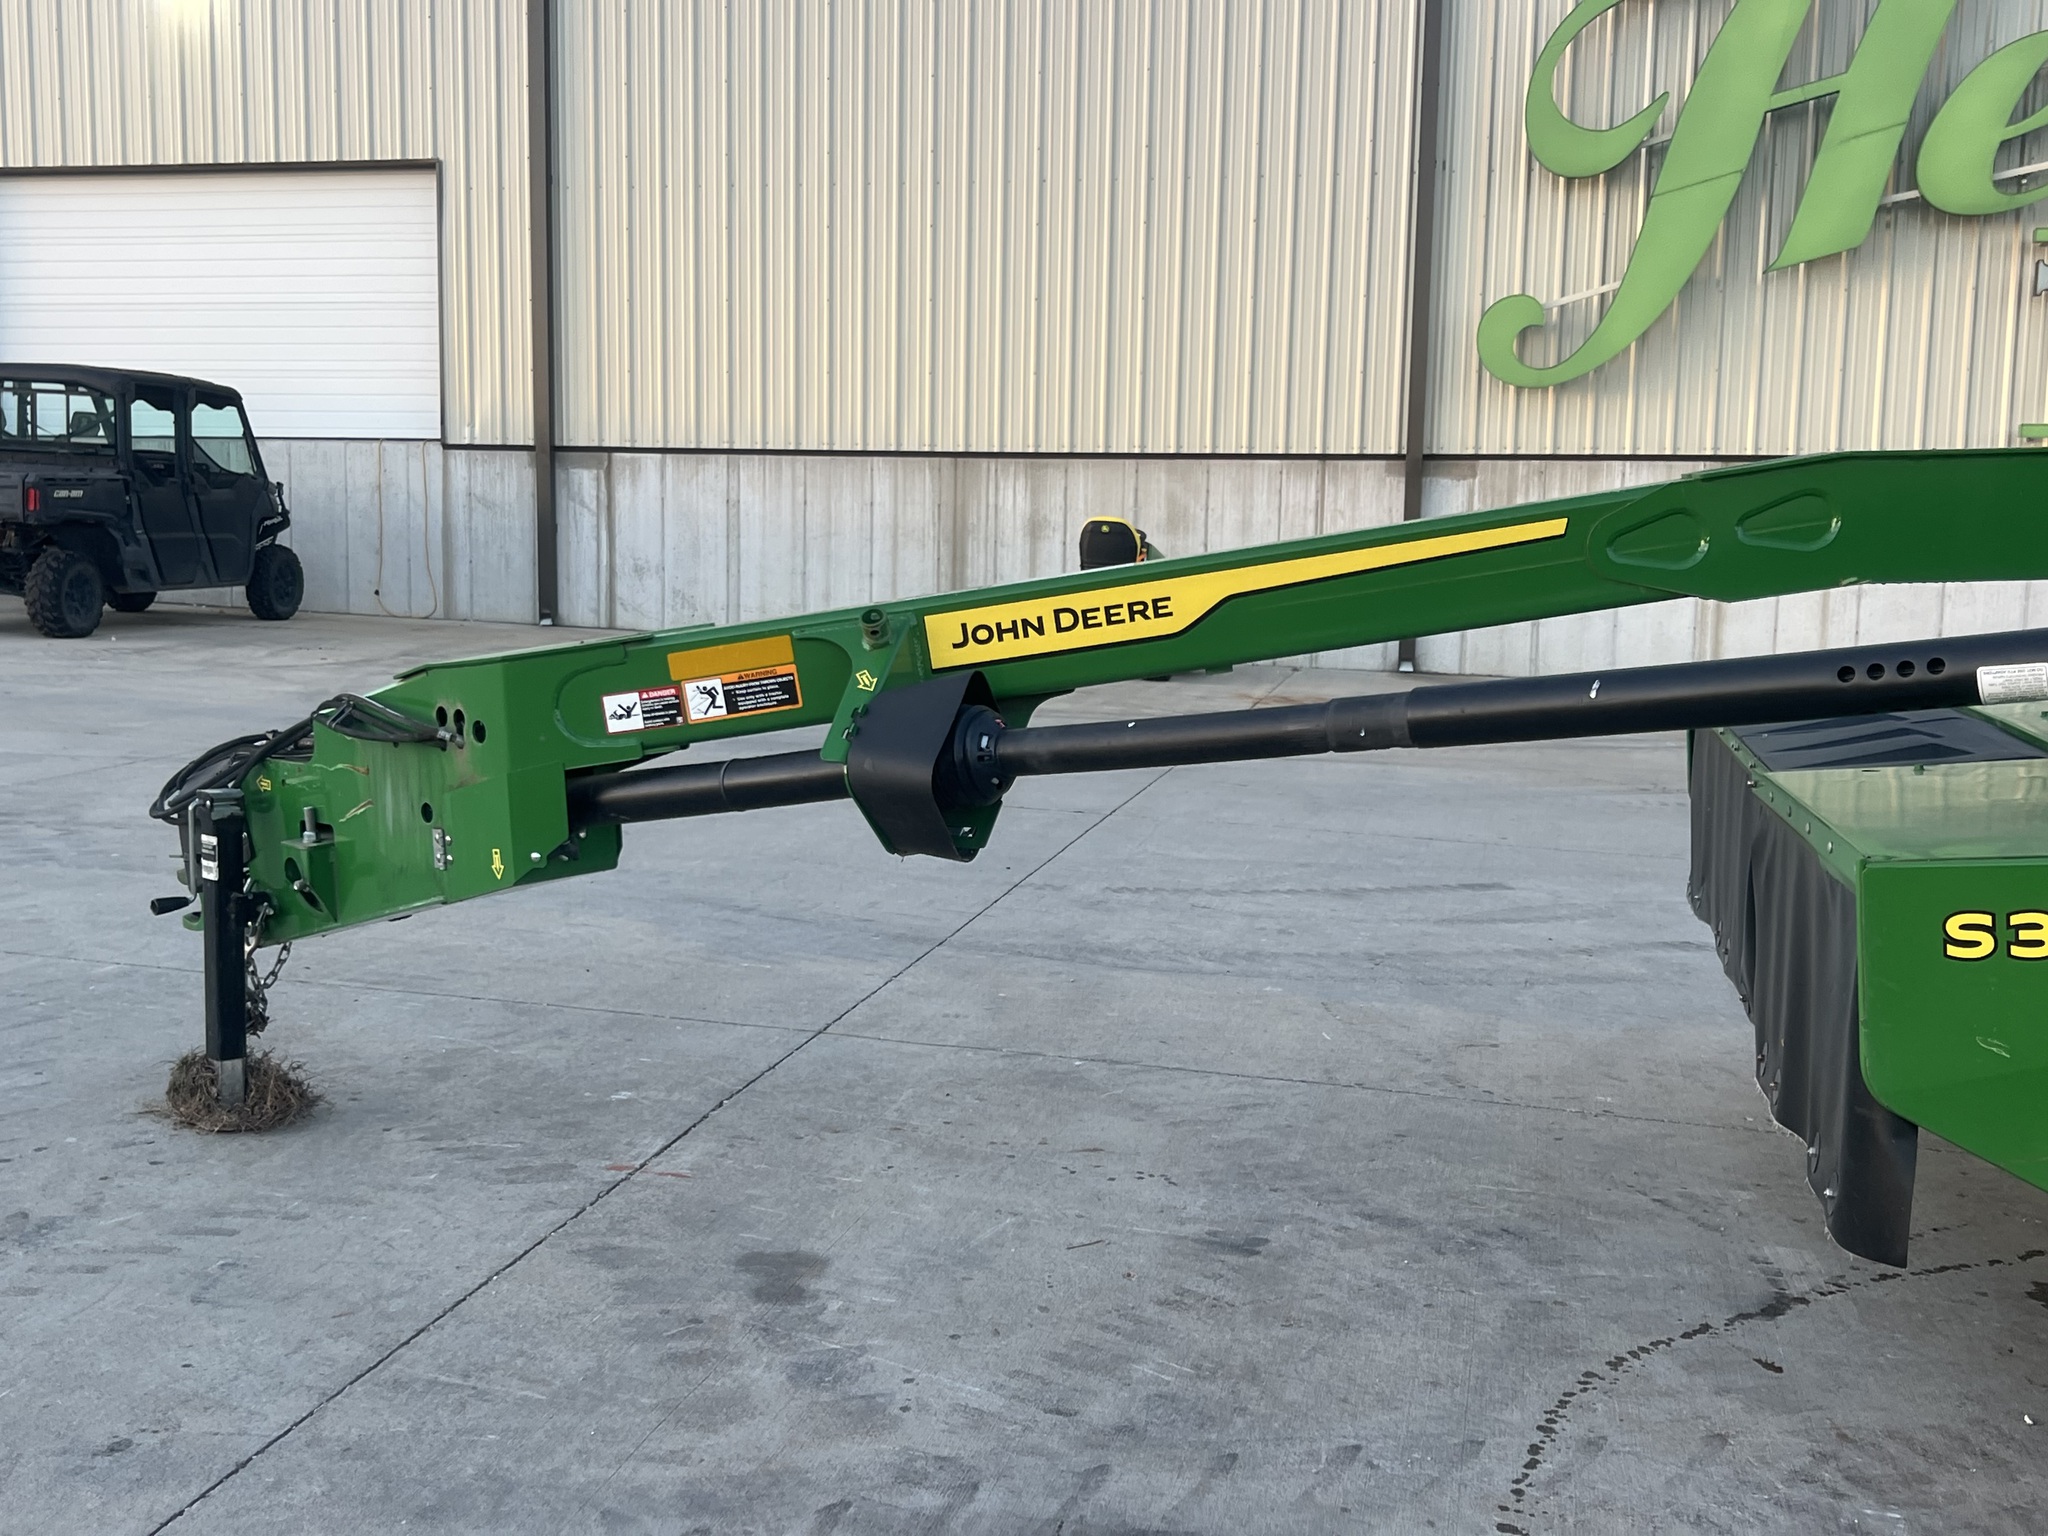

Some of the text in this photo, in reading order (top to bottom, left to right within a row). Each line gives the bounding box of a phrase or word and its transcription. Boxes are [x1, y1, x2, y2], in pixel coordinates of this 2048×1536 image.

[952, 596, 1174, 649] JOHN DEERE
[743, 668, 778, 679] WARNING
[648, 688, 676, 698] DANGER
[1942, 909, 2048, 961] S3
